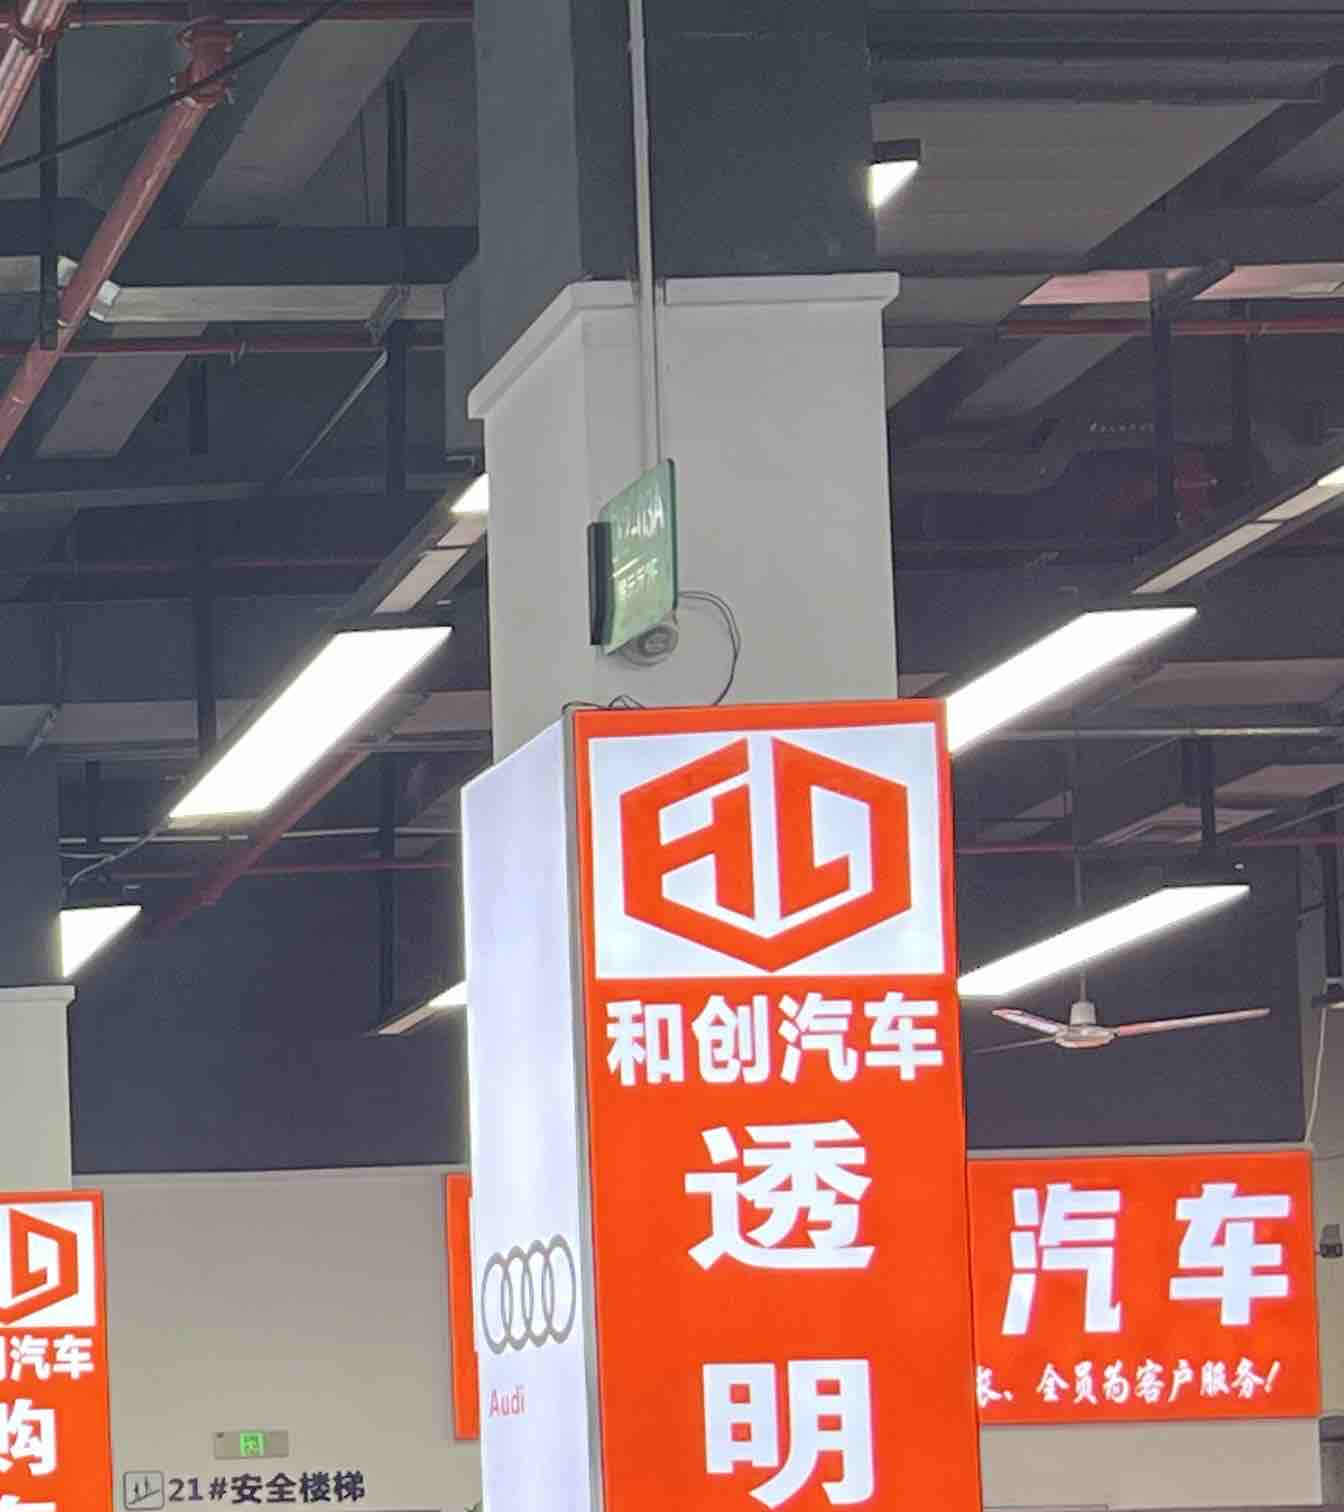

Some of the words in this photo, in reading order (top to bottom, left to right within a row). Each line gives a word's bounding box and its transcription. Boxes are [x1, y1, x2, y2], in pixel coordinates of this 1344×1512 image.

[606, 991, 944, 1088] 和创汽车
[1002, 1182, 1293, 1336] 汽车
[488, 1385, 526, 1418] Audi
[168, 1470, 366, 1504] 21#安全楼梯
